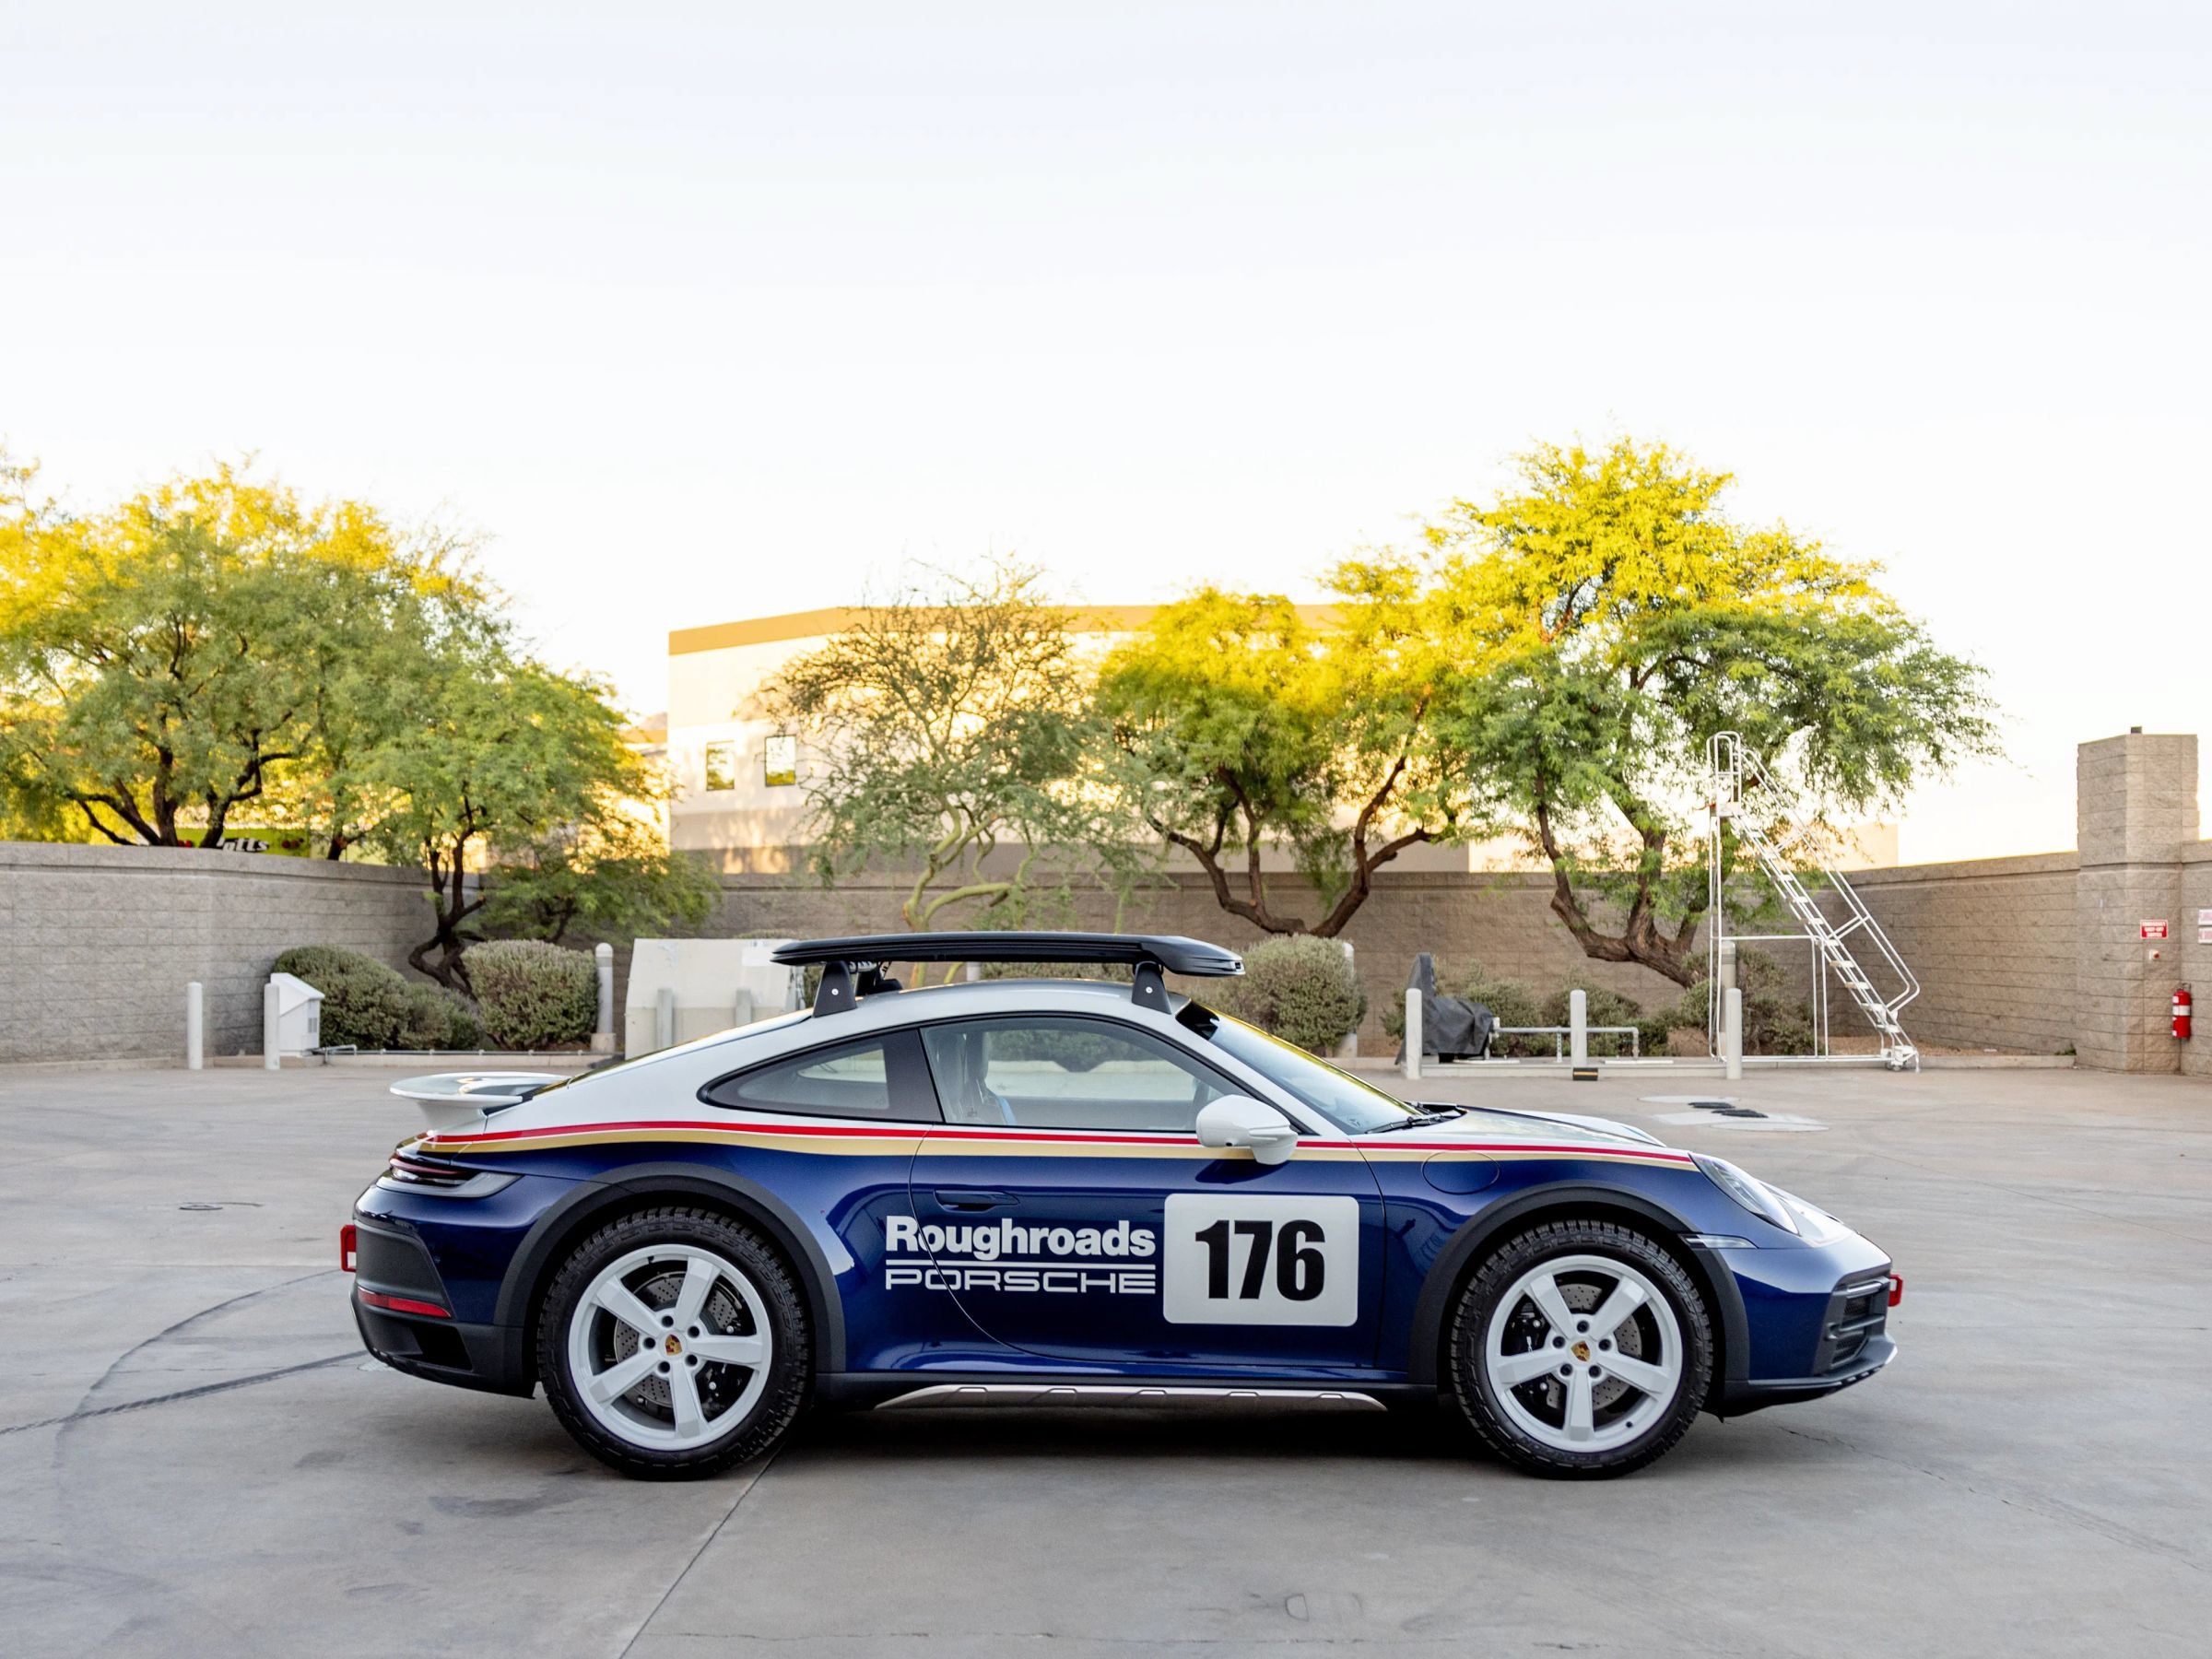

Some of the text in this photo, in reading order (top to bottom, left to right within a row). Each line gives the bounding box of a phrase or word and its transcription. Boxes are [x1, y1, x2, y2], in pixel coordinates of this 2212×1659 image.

[886, 1216, 1156, 1261] Roughroads
[1195, 1219, 1325, 1301] 176
[886, 1269, 1156, 1294] PORSCHE
